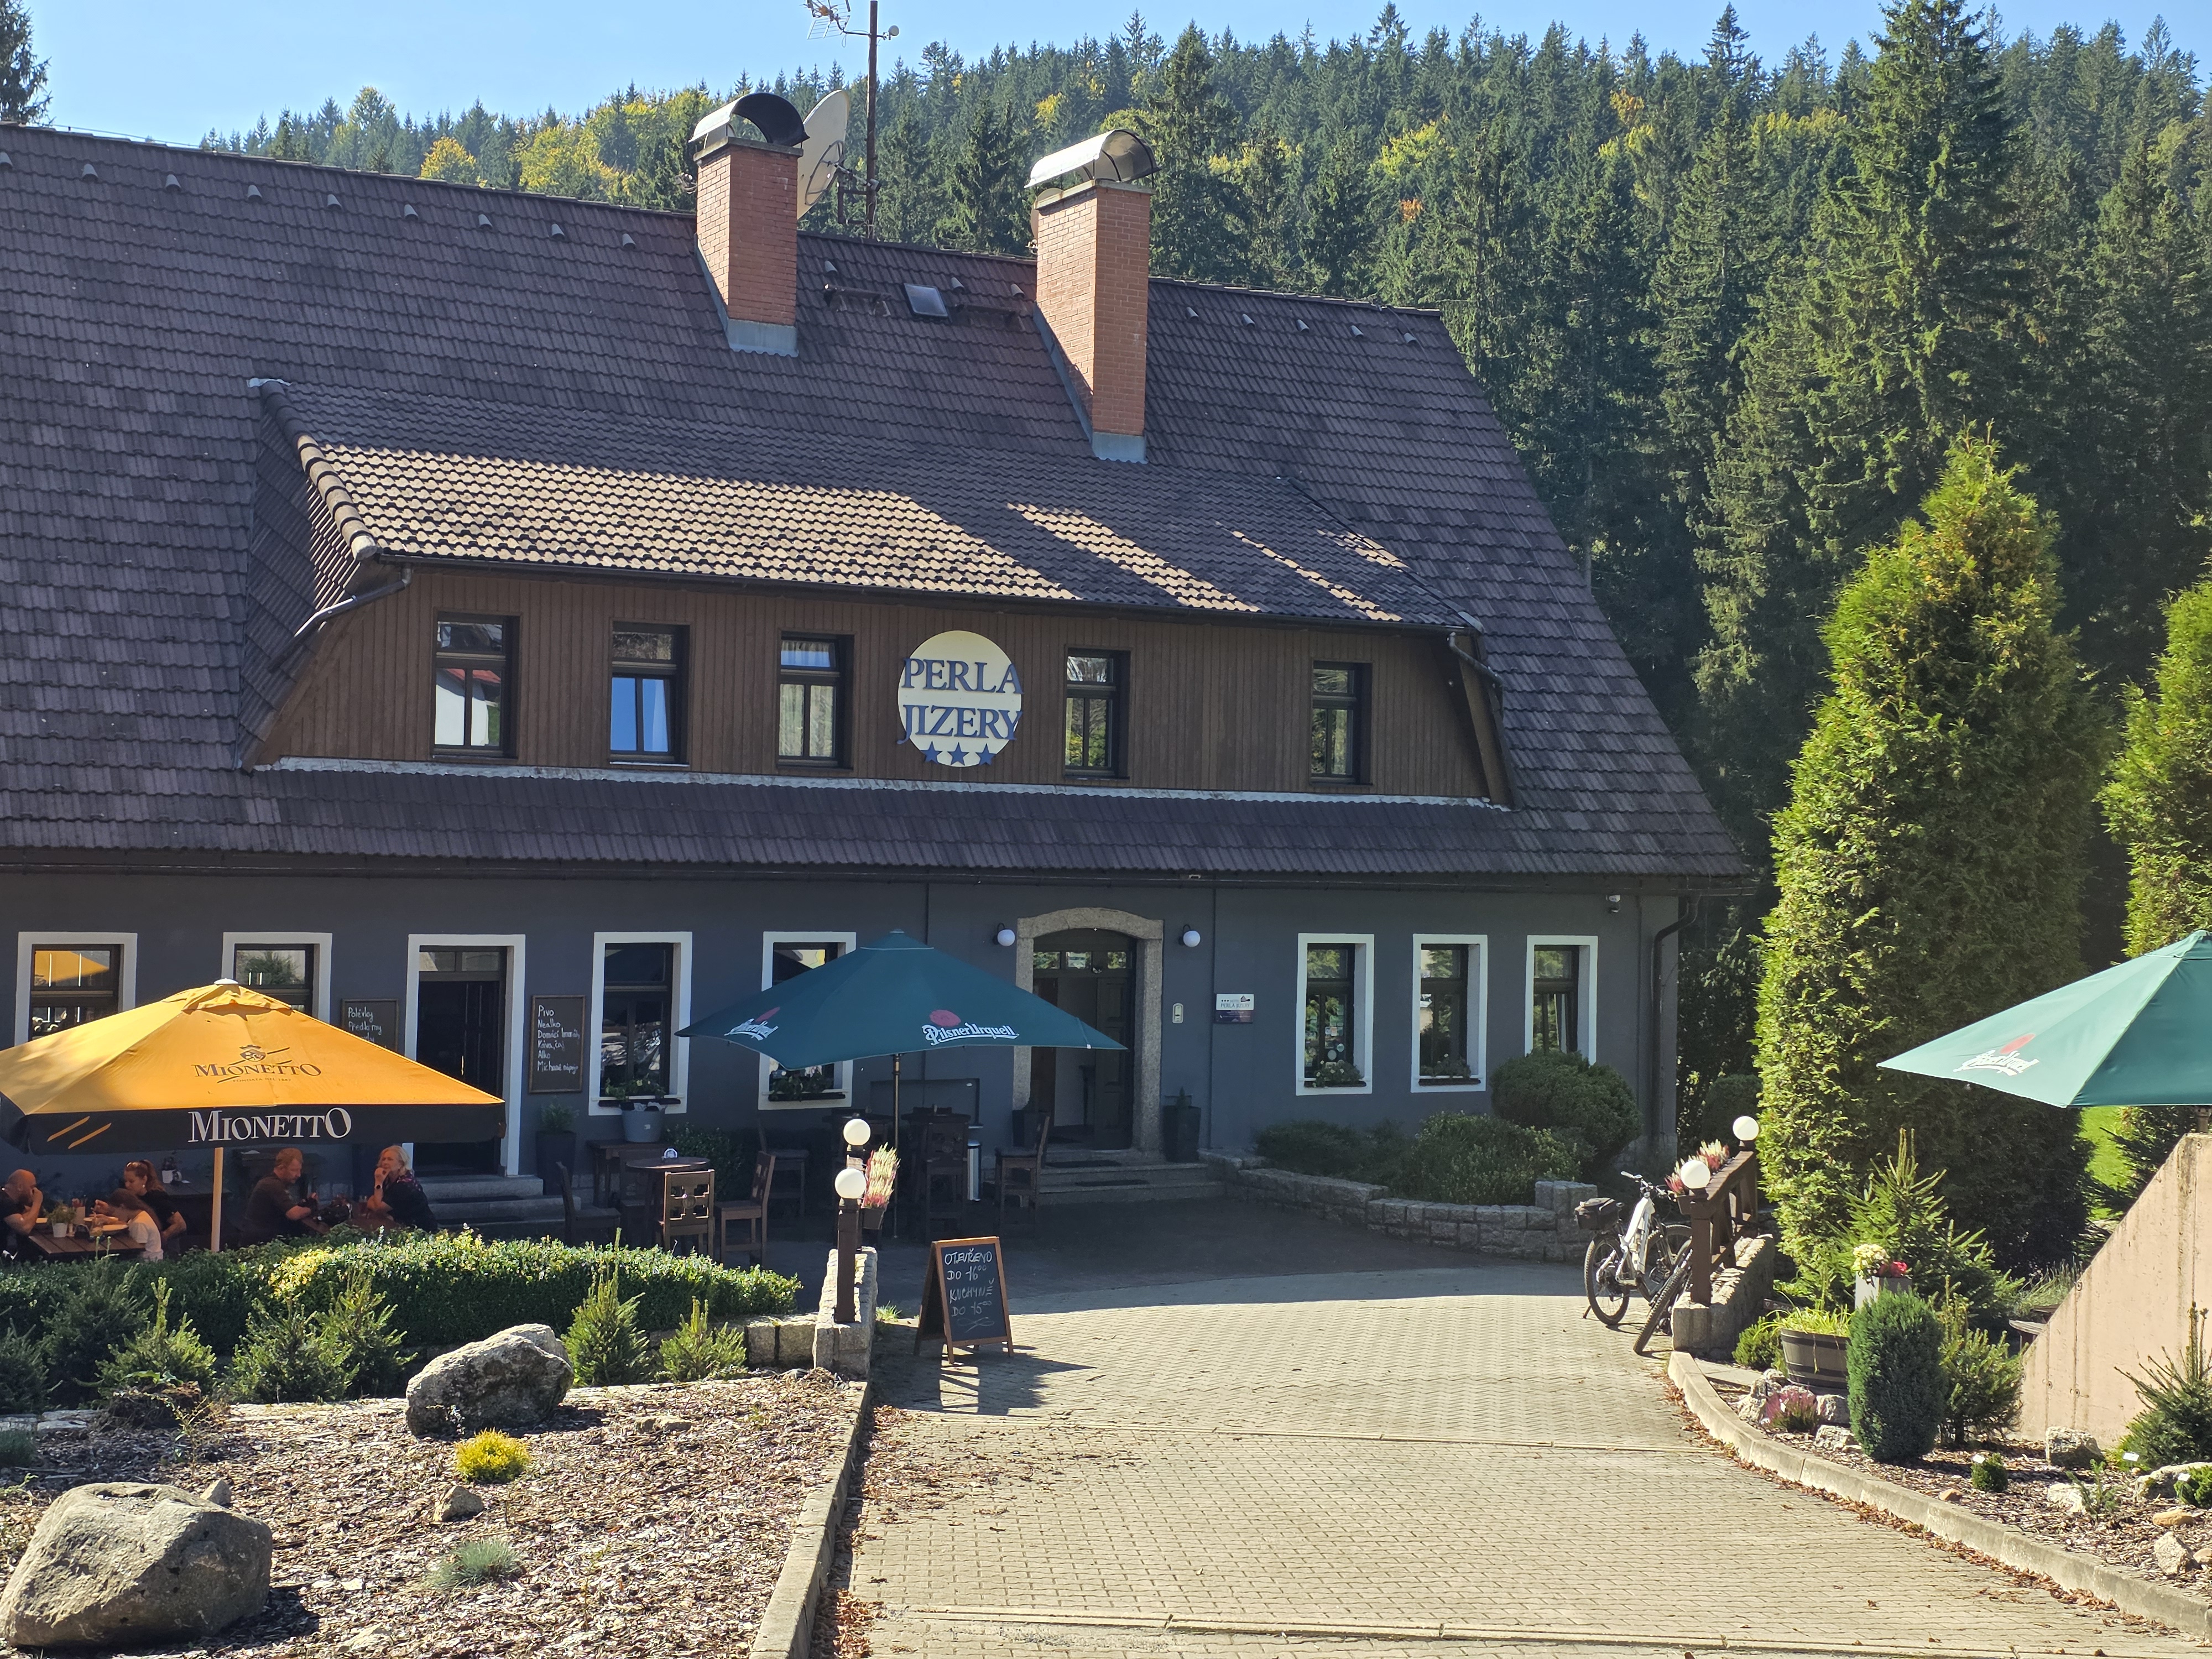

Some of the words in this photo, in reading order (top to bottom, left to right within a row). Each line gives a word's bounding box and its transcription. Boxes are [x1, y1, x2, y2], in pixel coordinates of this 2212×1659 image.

[901, 658, 1024, 694] PERLA
[896, 705, 1022, 744] JIZERY
[921, 1024, 970, 1046] Pilsner
[964, 1022, 1016, 1039] Urquell
[191, 1063, 322, 1077] MIONETTO
[187, 1107, 352, 1142] MIONETTO
[944, 1247, 993, 1265] OTEVŘENO
[946, 1270, 962, 1280] DO
[950, 1278, 995, 1303] KUCHYNĚ
[952, 1306, 966, 1317] DO
